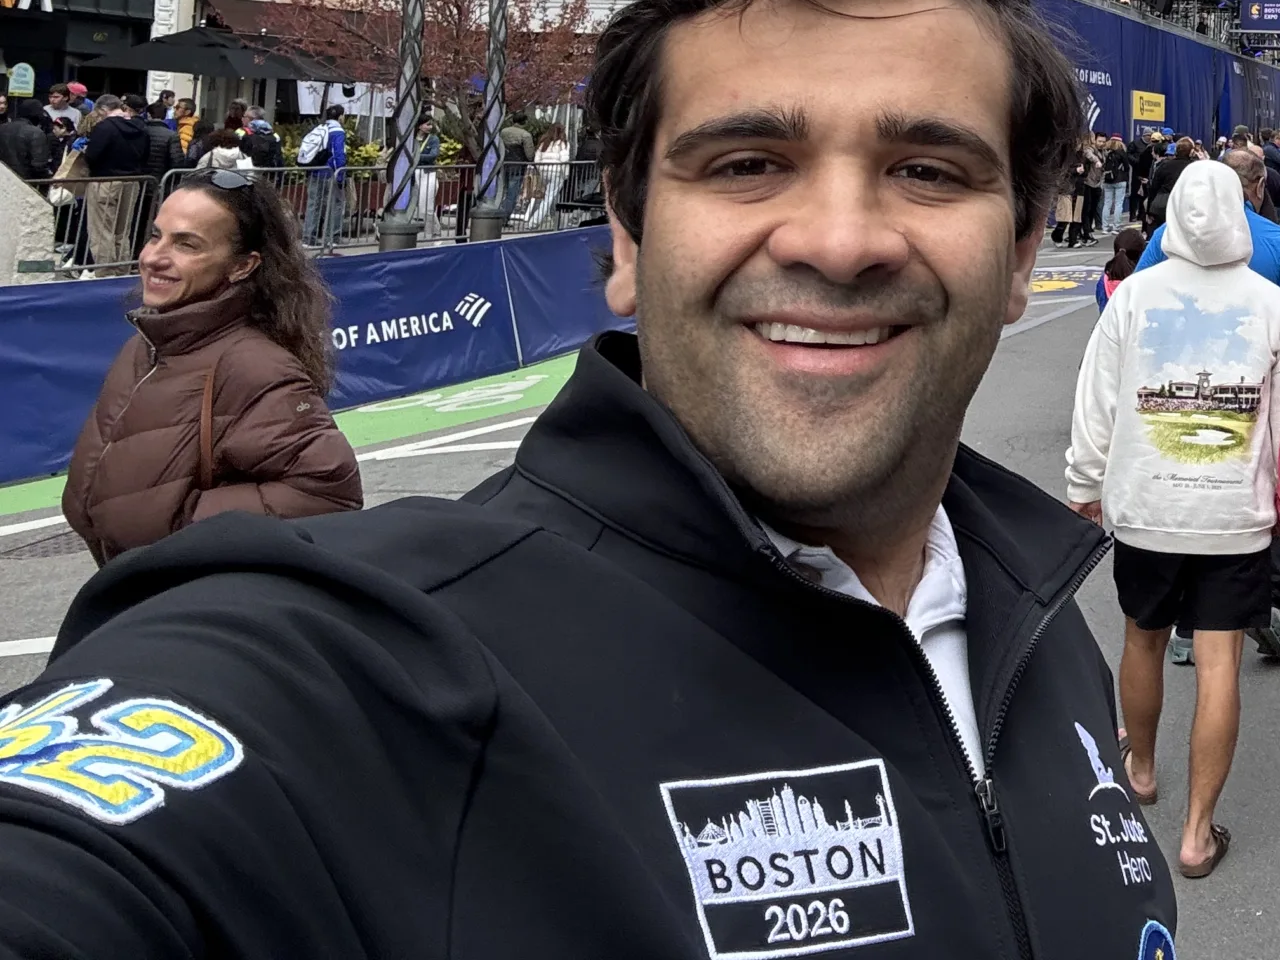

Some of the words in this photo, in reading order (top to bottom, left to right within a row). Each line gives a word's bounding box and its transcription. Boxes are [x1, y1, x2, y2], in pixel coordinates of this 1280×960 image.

[331, 326, 358, 350] OF
[366, 311, 454, 345] AMERICA
[1090, 814, 1121, 846] St.
[1119, 812, 1149, 843] Jude
[704, 838, 886, 893] BOSTON
[1117, 851, 1152, 886] Hero
[764, 898, 850, 944] 2026
